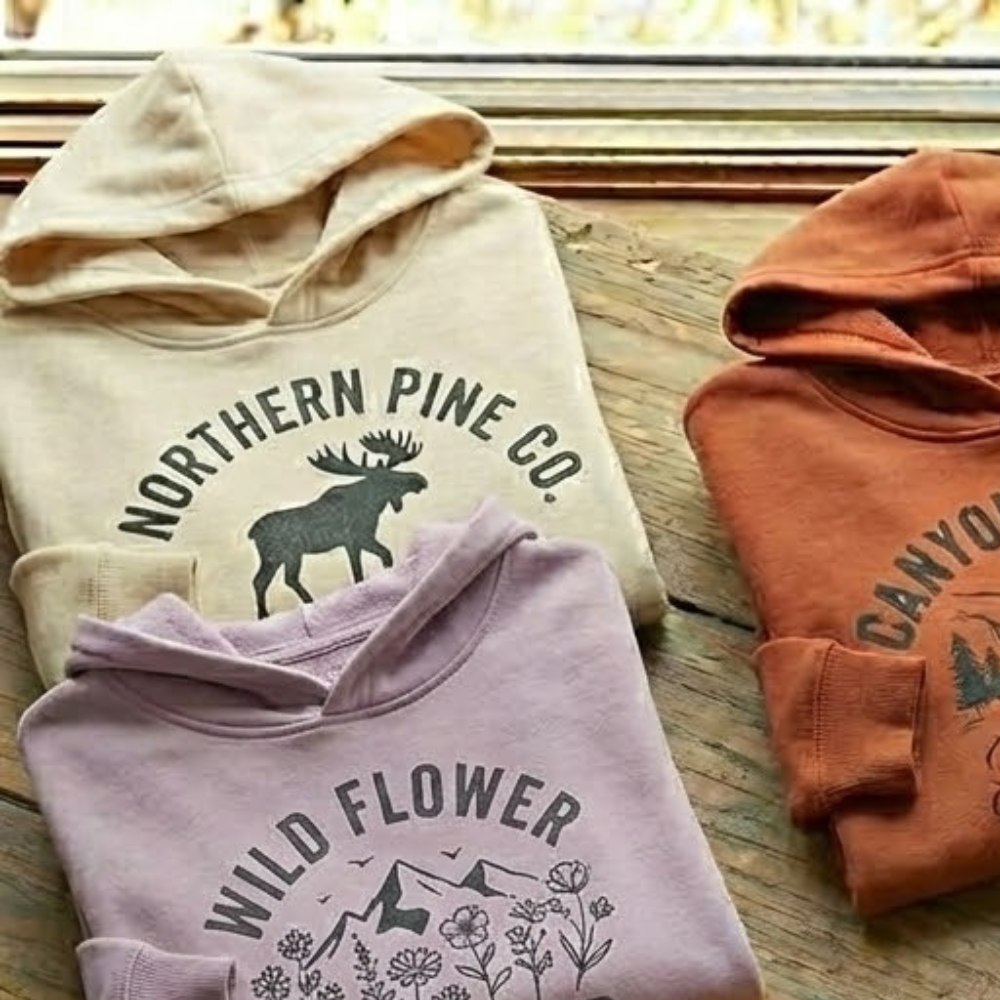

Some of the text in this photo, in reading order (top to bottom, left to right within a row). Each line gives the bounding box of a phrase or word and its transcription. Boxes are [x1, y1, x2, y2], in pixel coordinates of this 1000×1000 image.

[118, 367, 583, 541] NORTHERN PINE CO.
[204, 763, 582, 939] WILD FLOWER
